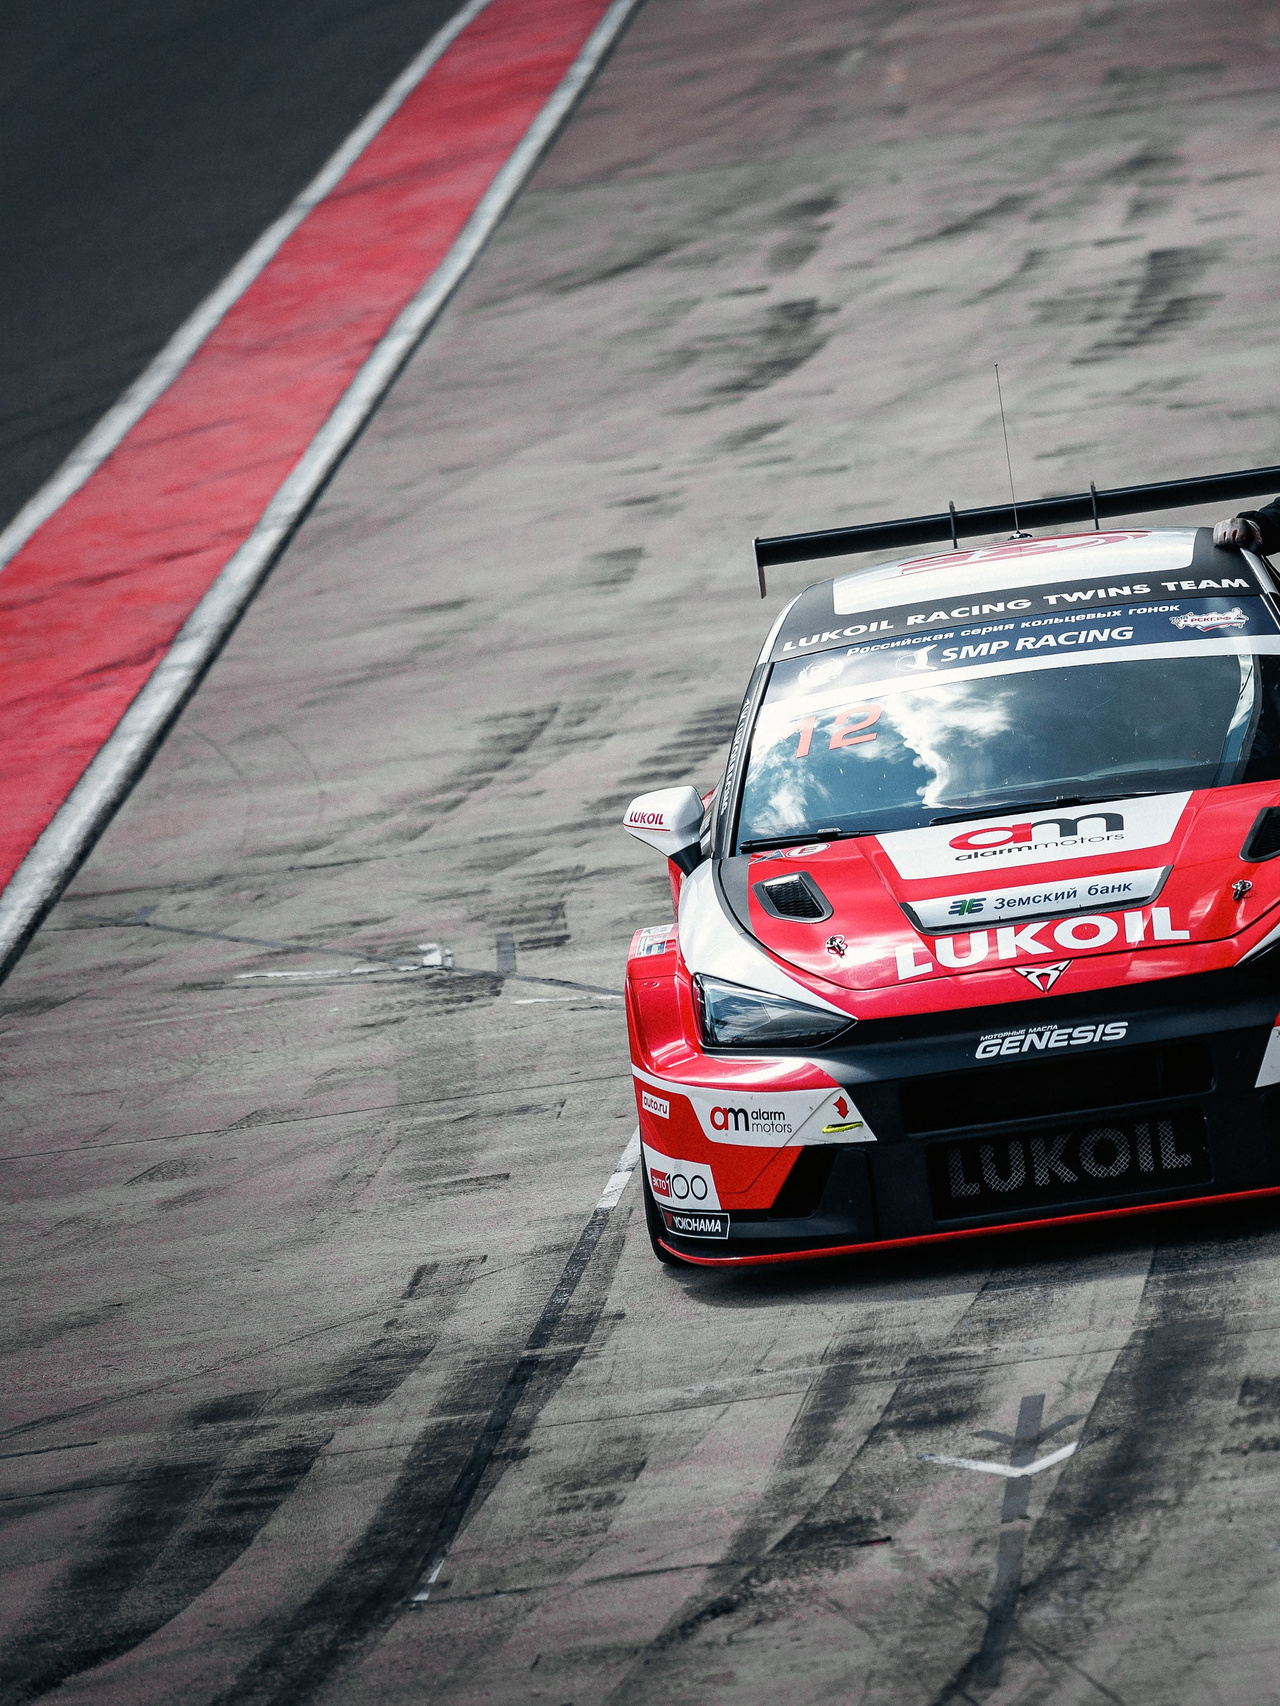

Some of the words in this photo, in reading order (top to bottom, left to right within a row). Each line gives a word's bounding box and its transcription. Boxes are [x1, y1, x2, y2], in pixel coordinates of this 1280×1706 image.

[783, 620, 894, 652] LUKOIL
[906, 599, 1032, 626] RACING
[1043, 584, 1151, 605] TWINS
[1161, 579, 1250, 592] TEAM
[846, 632, 954, 657] Российская
[961, 623, 1014, 637] серия
[1020, 610, 1122, 629] кольцевых
[1128, 604, 1180, 616] гонок
[940, 641, 1010, 663] SMP
[1015, 626, 1134, 651] RACING
[781, 703, 883, 759] 12
[629, 811, 664, 825] LUKOIL
[993, 887, 1078, 910] Земский
[1088, 881, 1133, 896] банк
[895, 907, 1191, 981] LUKOIL
[975, 1021, 1129, 1059] GENESIS
[980, 1028, 1026, 1041] МОТОРНЫЕ
[1028, 1024, 1059, 1034] МАСЛА
[643, 1095, 668, 1115] auto.ru
[710, 1106, 749, 1132] am
[751, 1108, 785, 1121] alarm
[751, 1120, 793, 1134] motors
[949, 1120, 1193, 1198] LUKOIL
[673, 1215, 722, 1233] YOKOHAMA
